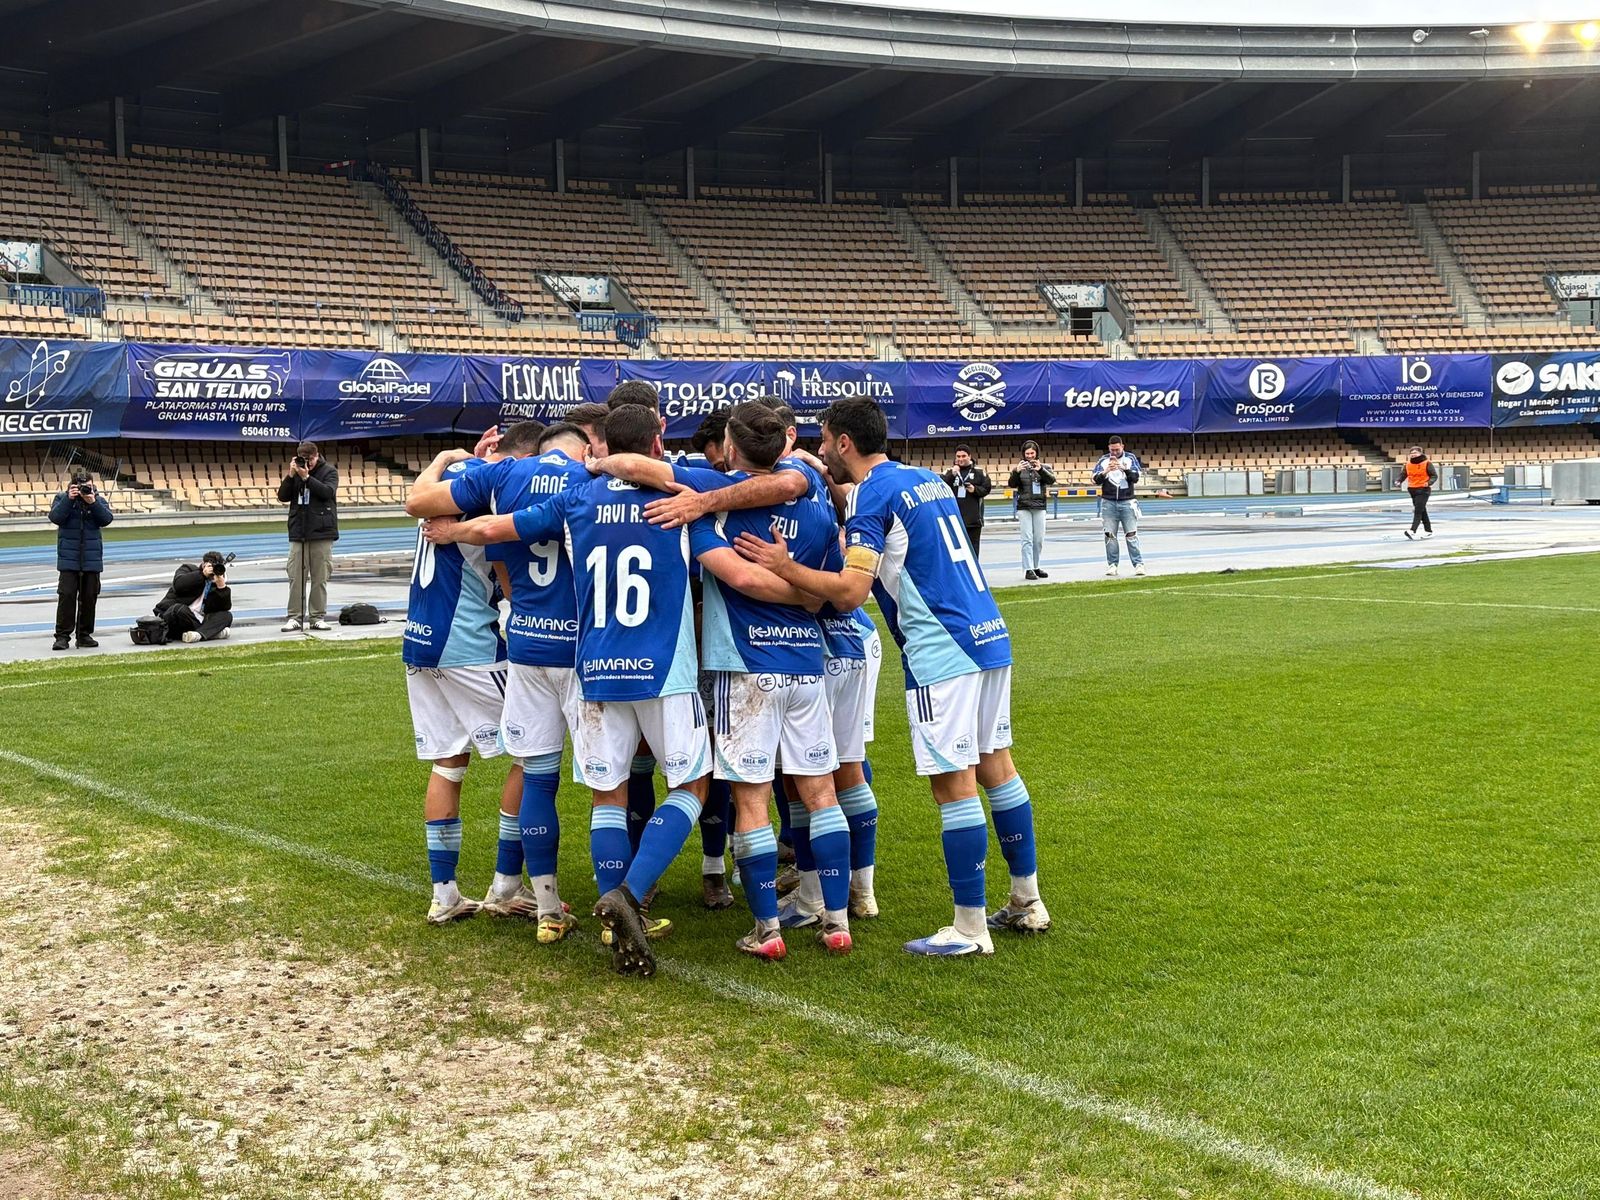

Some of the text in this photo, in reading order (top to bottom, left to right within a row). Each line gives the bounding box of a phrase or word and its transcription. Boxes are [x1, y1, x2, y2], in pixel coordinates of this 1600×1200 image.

[153, 358, 271, 379] GRÚAS
[801, 368, 823, 381] LA
[338, 380, 432, 395] GlobalPadel
[502, 360, 584, 401] PESCACHÉ
[155, 381, 273, 399] SAN TELMO
[802, 380, 894, 397] FRESQUITA
[144, 401, 287, 412] PLATAFORMAS HASTA 90 MTS.
[370, 395, 401, 404] CLUB
[1064, 385, 1180, 416] telepizza
[1498, 400, 1523, 409] Hogar
[1529, 398, 1560, 406] Menaje
[1566, 396, 1591, 404] Textil
[158, 412, 270, 423] GRUAS HASTA 116 MTS.
[499, 403, 537, 418] PESCADOS
[537, 404, 546, 418] Y
[1235, 403, 1295, 417] ProSport
[242, 426, 291, 437] 650461785
[901, 490, 919, 510] A.
[595, 503, 643, 524] JAVI R.
[937, 514, 985, 592] 4
[528, 540, 560, 587] 9
[586, 544, 652, 628] 16
[861, 818, 877, 828] XC
[522, 826, 547, 836] XCD
[598, 860, 624, 870] XCD
[818, 868, 839, 876] XCD
